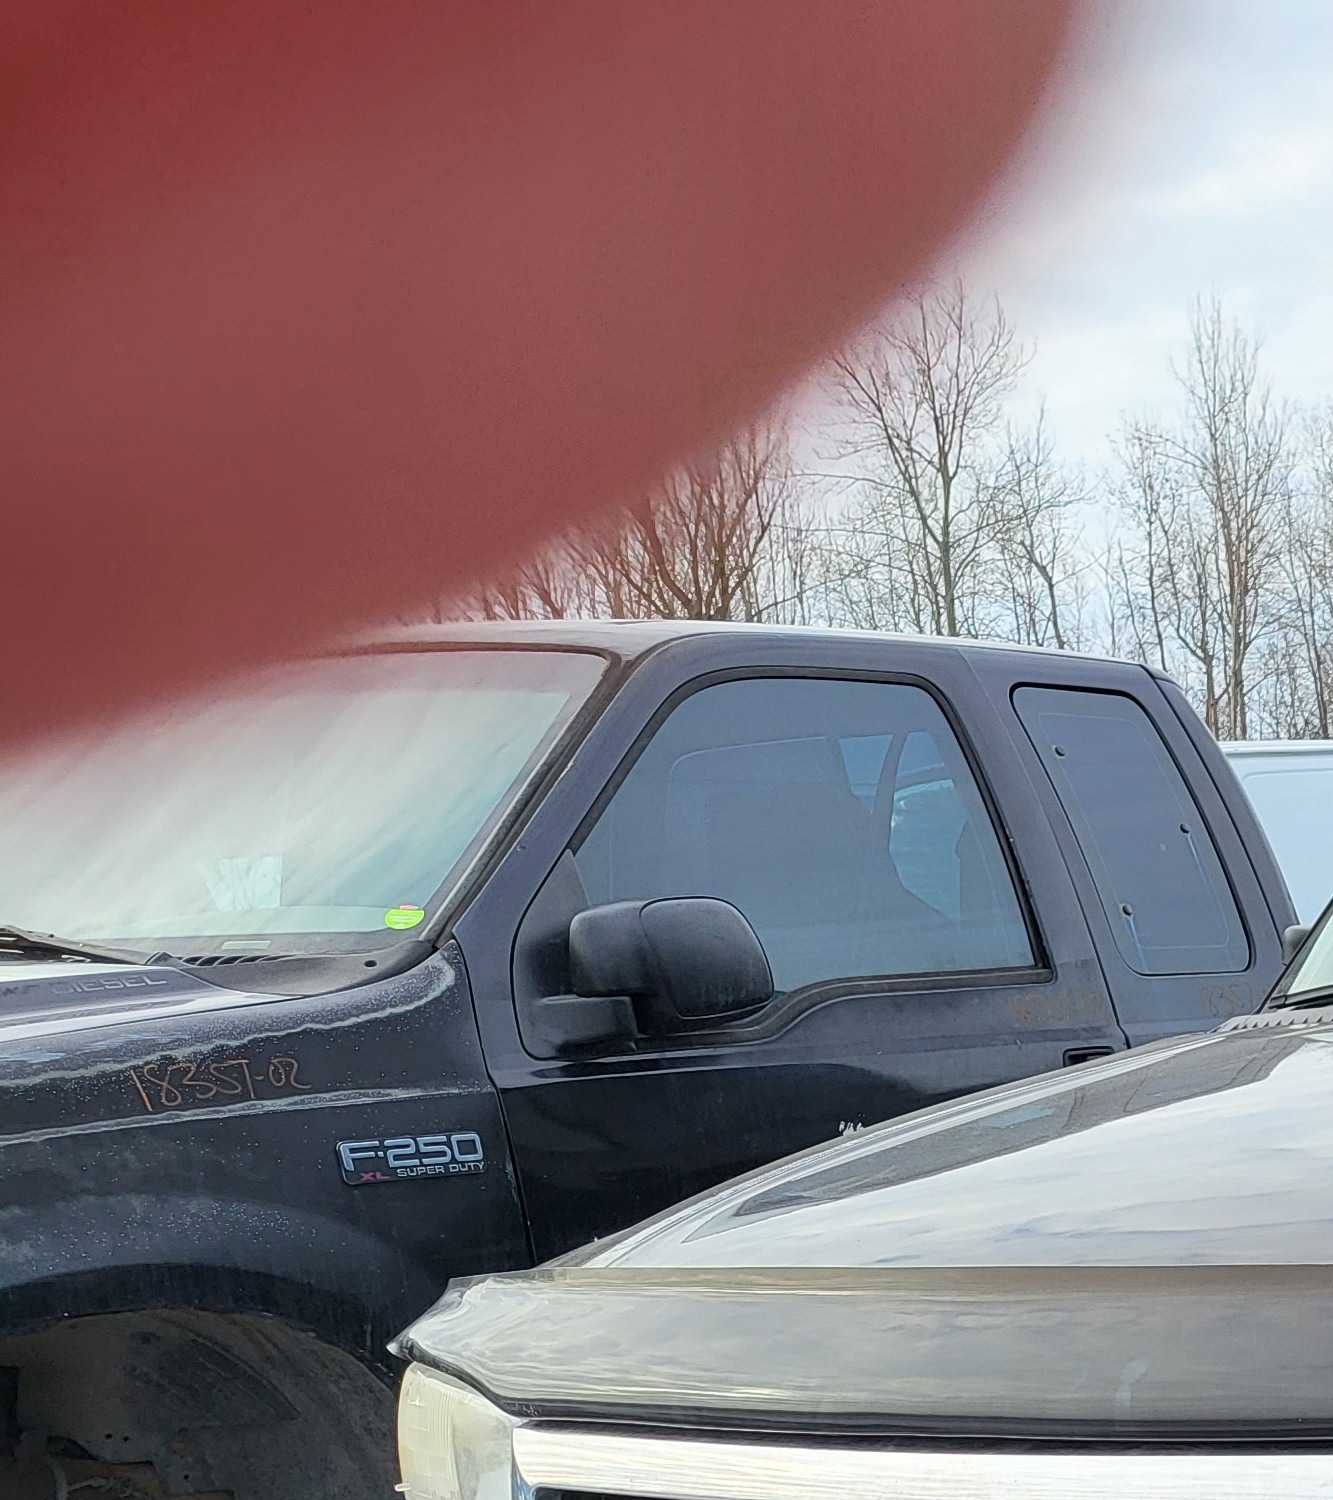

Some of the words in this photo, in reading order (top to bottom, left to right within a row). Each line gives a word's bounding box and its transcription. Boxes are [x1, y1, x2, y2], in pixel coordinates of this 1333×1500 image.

[339, 1133, 484, 1172] F-250
[360, 1171, 390, 1182] XL
[396, 1164, 446, 1178] SUPER
[449, 1161, 486, 1172] DUTY
